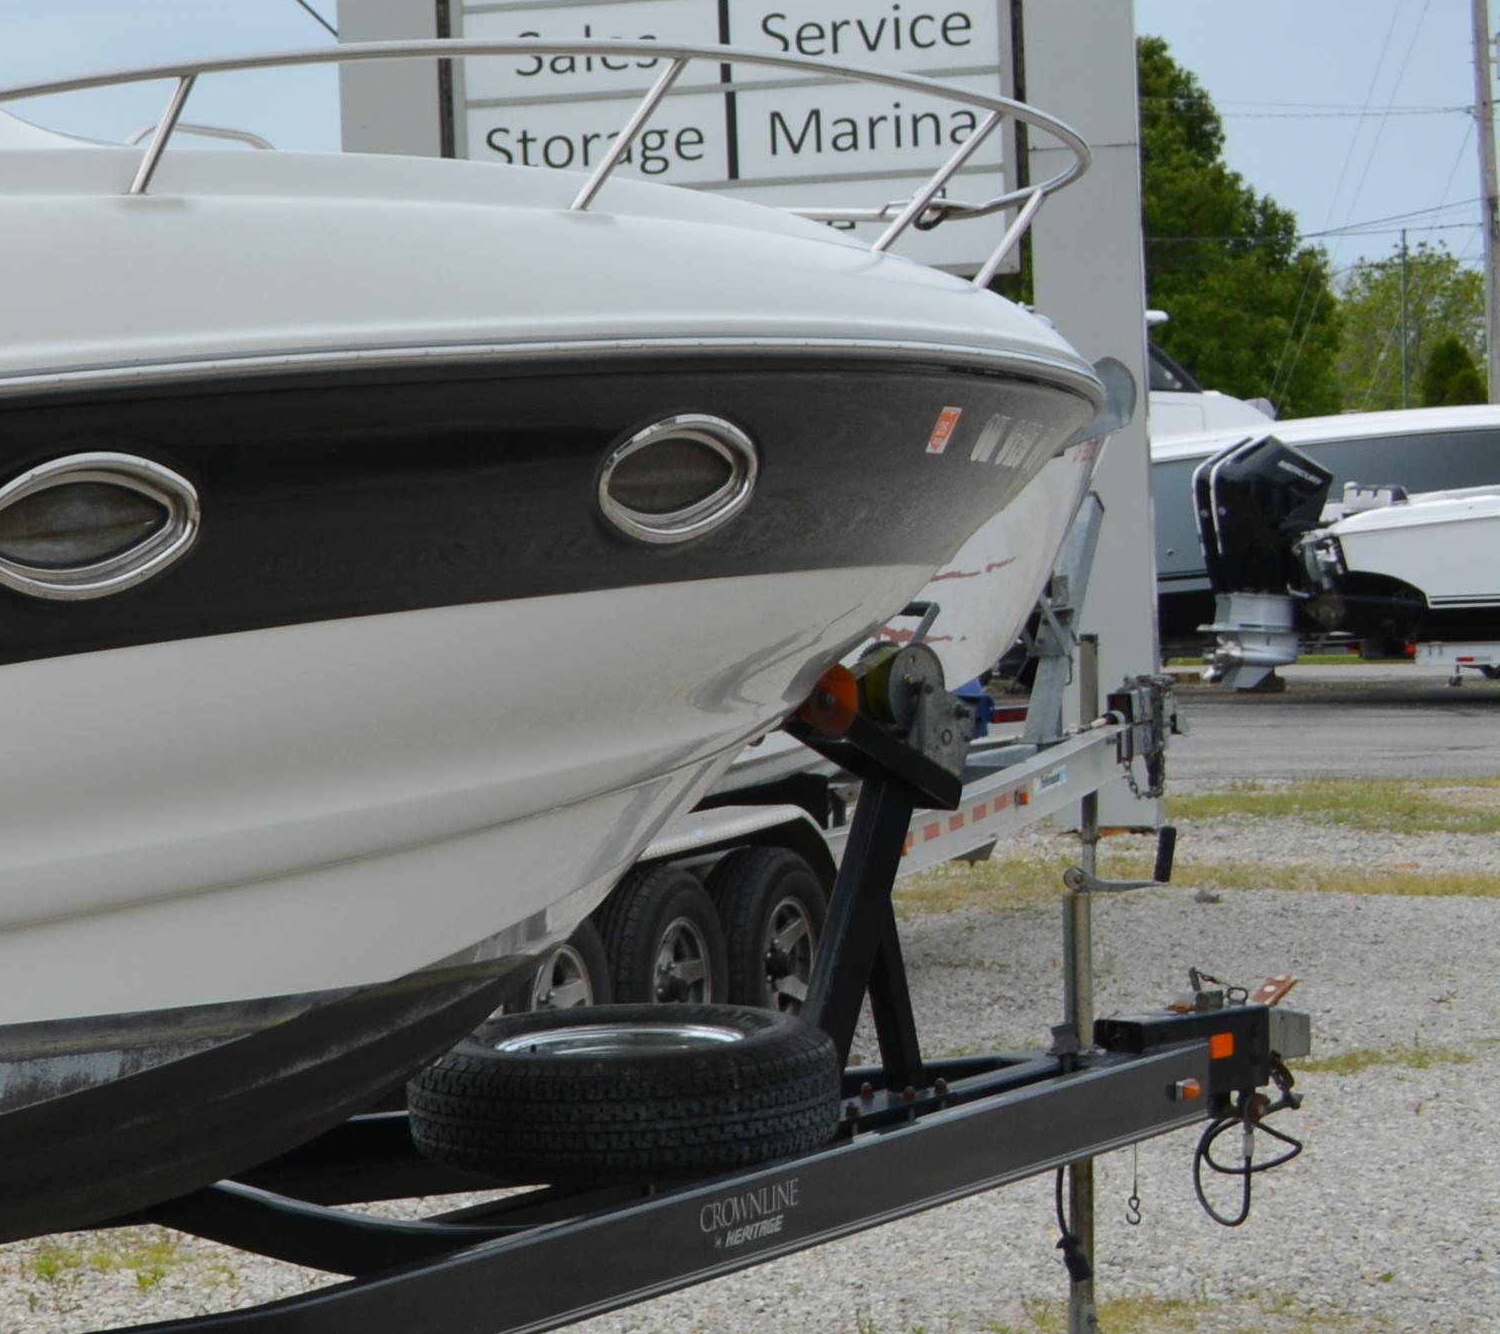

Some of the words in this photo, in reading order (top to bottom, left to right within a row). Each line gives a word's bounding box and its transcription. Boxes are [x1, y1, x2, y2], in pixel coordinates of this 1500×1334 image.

[761, 4, 971, 56] Service
[769, 102, 977, 156] Marina
[700, 1178, 799, 1233] CROWNLINE
[725, 1216, 784, 1247] HERITAGE
